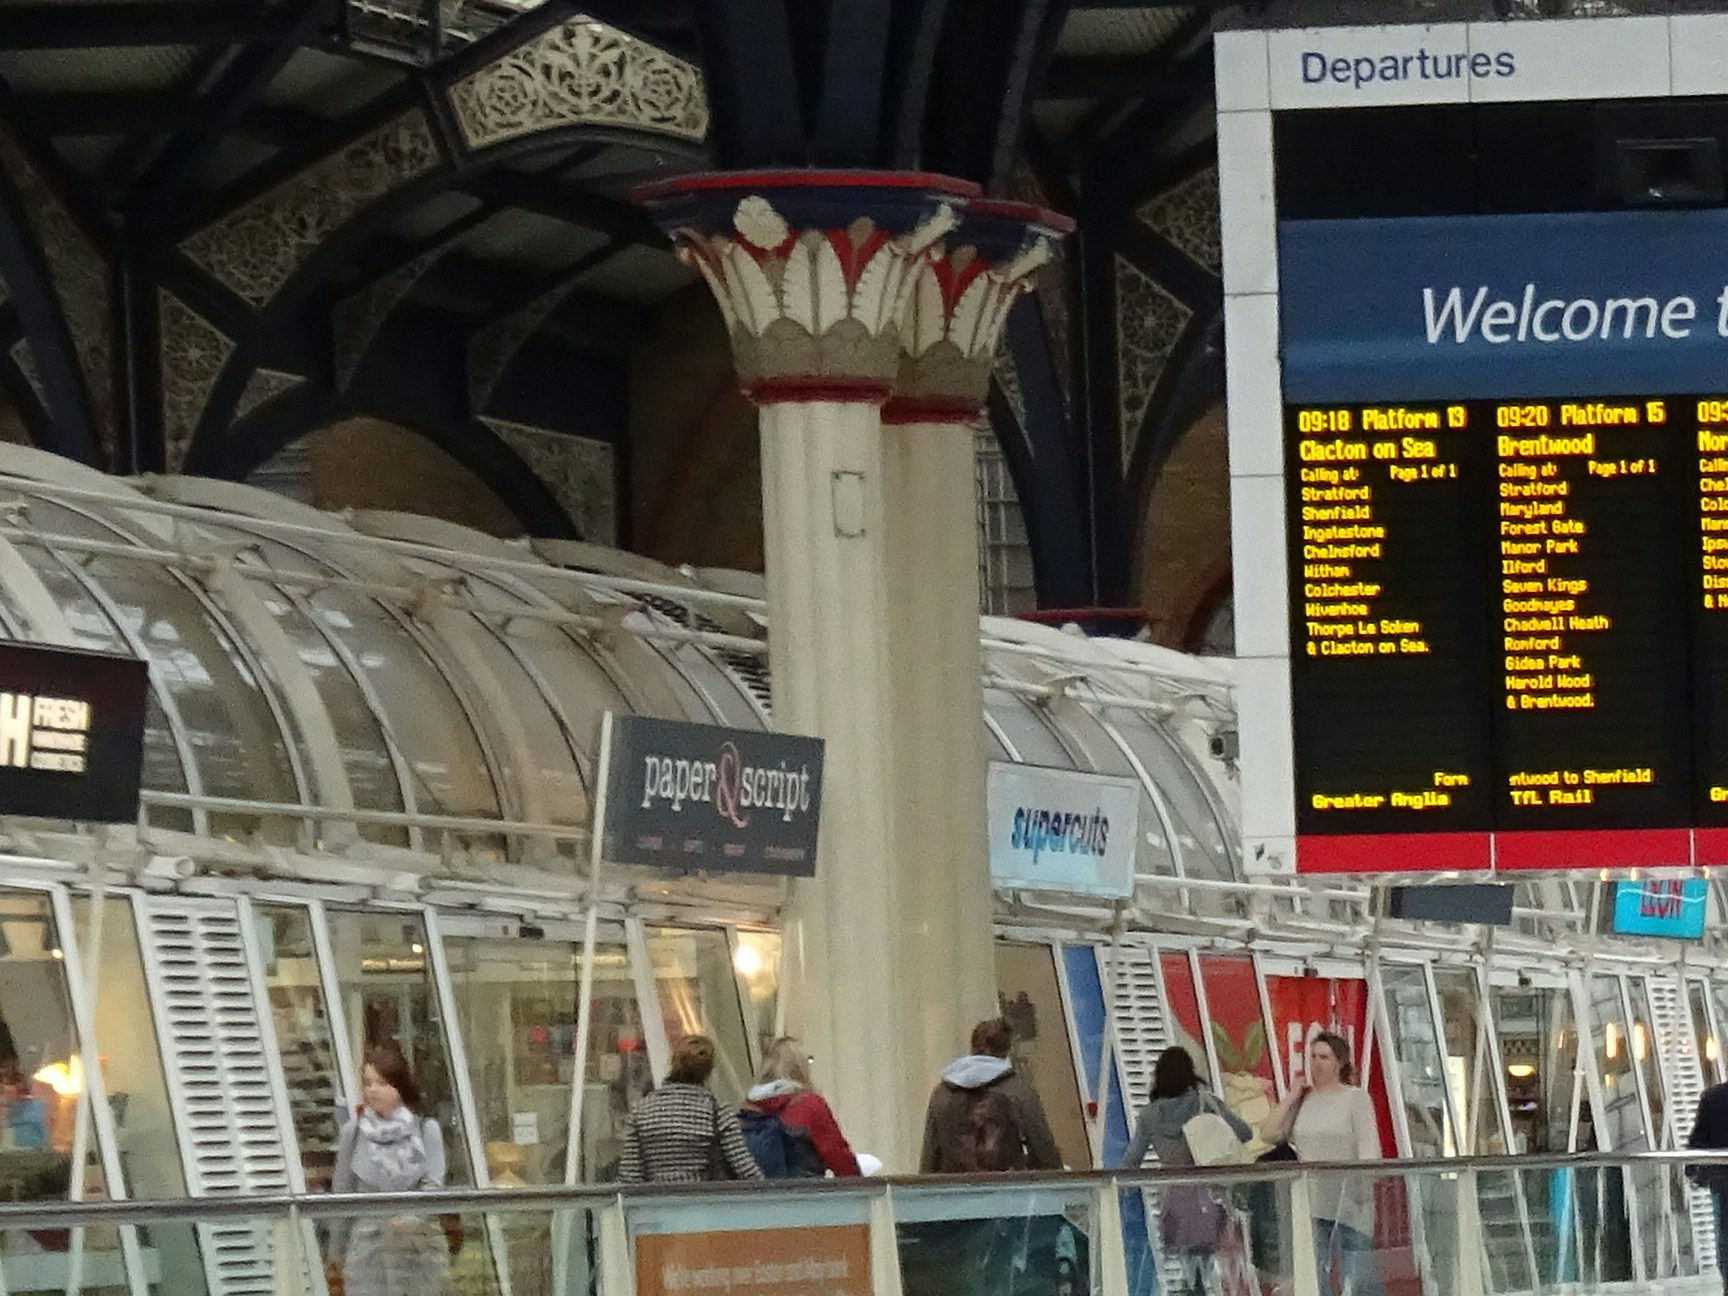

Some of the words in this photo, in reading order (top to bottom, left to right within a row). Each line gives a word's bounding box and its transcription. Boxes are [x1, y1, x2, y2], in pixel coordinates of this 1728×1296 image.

[1301, 48, 1516, 88] Departures
[1424, 284, 1695, 342] Welcome
[1299, 411, 1351, 432] 09:18
[1363, 409, 1440, 430] Platform
[1447, 407, 1466, 427] 13
[1497, 406, 1548, 427] 09:20
[1561, 404, 1639, 425] Platform
[1646, 402, 1665, 422] 15
[1299, 439, 1369, 462] Clacton
[1372, 442, 1398, 460] on
[1402, 436, 1437, 459] Sea
[1498, 433, 1594, 456] Brentwood
[1312, 792, 1385, 809] Greater
[1390, 790, 1449, 810] Anglia
[1010, 803, 1110, 860] supercuts
